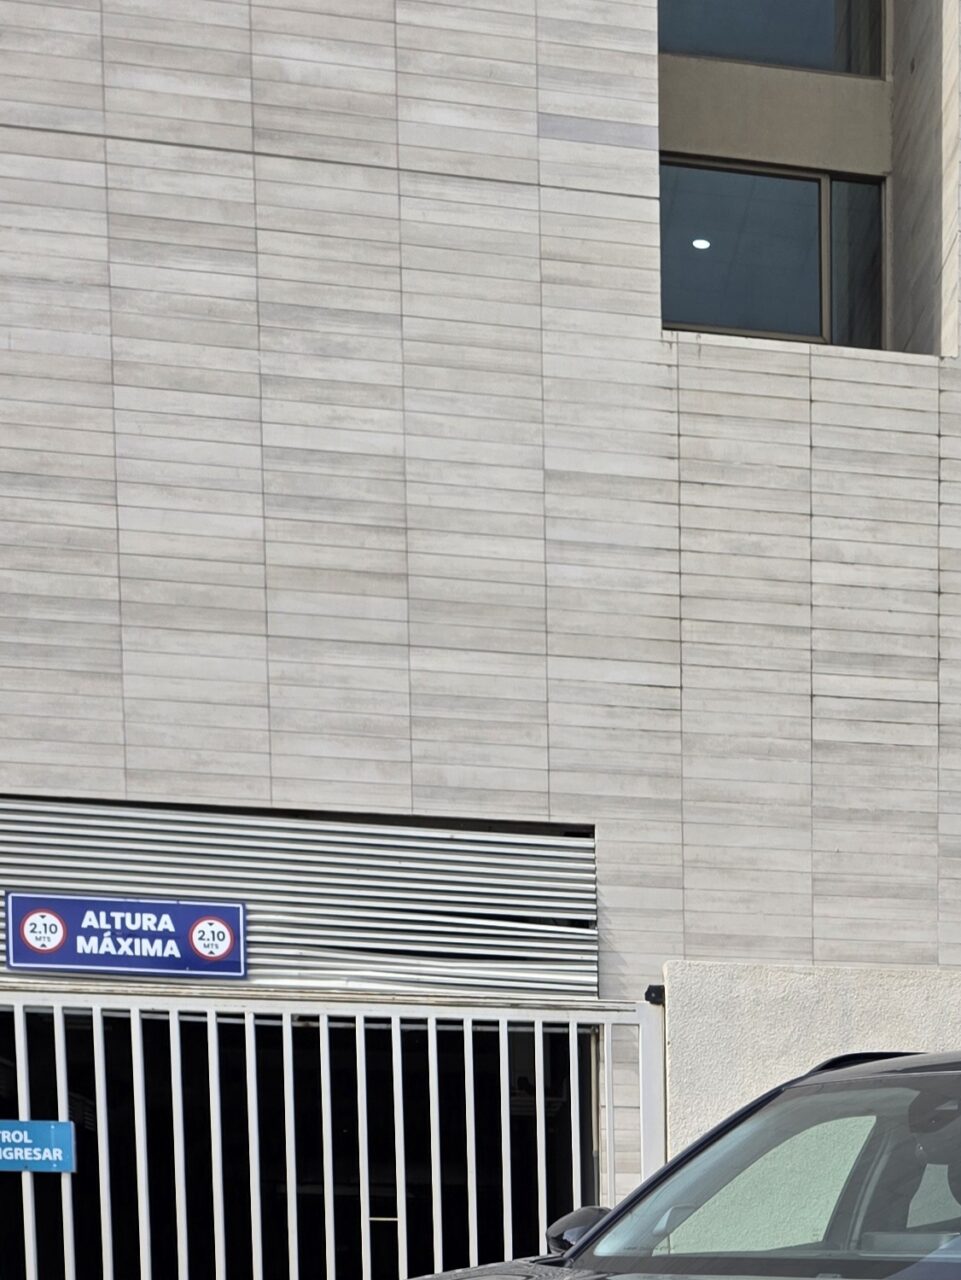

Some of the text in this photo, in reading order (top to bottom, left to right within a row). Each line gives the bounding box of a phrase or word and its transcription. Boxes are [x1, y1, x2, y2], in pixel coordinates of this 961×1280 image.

[81, 910, 175, 932] ALTURA
[29, 922, 58, 934] 2.10
[197, 930, 226, 942] 2.10
[76, 931, 181, 958] MÁXIMA
[0, 1130, 33, 1143] ROL
[0, 1147, 63, 1161] GRESAR
